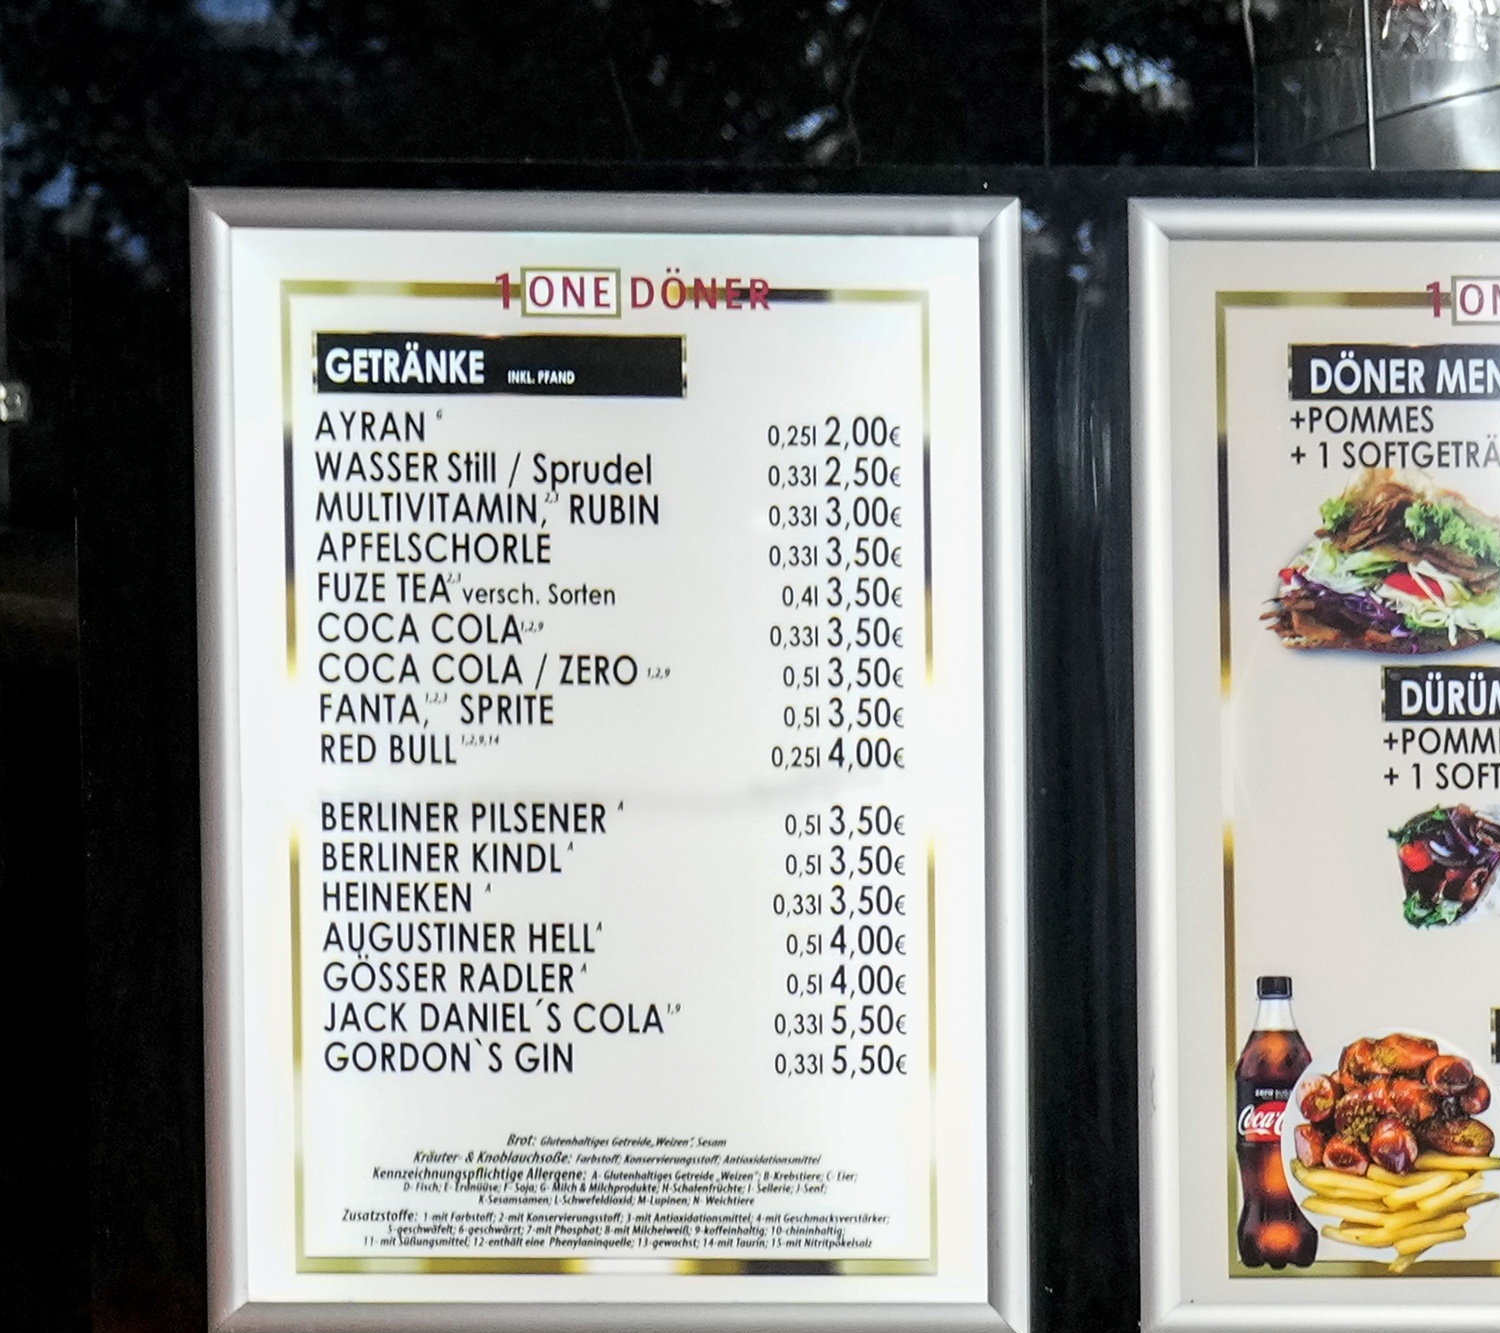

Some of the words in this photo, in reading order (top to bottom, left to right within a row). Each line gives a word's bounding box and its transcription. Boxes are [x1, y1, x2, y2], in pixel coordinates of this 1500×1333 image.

[529, 276, 613, 308] ONE
[630, 268, 771, 311] DÖNER
[326, 345, 484, 383] GETRÄNKE
[1311, 351, 1425, 394] DÖNER
[316, 411, 424, 441] AYRAN
[825, 416, 900, 450] 2,00€
[1290, 406, 1433, 433] +POMMES
[316, 452, 438, 482] WASSER
[448, 452, 495, 482] Still
[534, 453, 651, 491] Sprudel
[825, 456, 900, 490] 2,50€
[570, 494, 658, 524] RUBIN
[826, 496, 901, 530] 3,00€
[318, 532, 550, 563] APFELSCHORLE
[826, 536, 901, 570] 3,50€
[319, 573, 385, 602] FUZE
[397, 573, 452, 603] TEA
[463, 583, 539, 604] versch.
[549, 583, 615, 605] Sorten
[827, 577, 902, 611] 3,50€
[318, 612, 419, 643] COCA
[432, 613, 524, 644] COLA
[828, 617, 902, 651] 3,50€
[319, 653, 420, 683] COCA
[433, 653, 522, 684] COLA
[560, 655, 637, 685] ZERO
[828, 657, 903, 691] 3,50€
[461, 694, 553, 724] SPRITE
[829, 697, 903, 731] 3,50€
[322, 734, 376, 763] RED
[390, 735, 456, 764] BULL
[829, 737, 904, 771] 4,00€
[322, 802, 458, 832] BERLINER
[472, 803, 605, 833] PILSENER
[323, 843, 458, 872] BERLINER
[473, 843, 561, 873] KINDL
[323, 882, 471, 912] HEINEKEN
[324, 922, 515, 957] AUGUSTINER
[529, 923, 595, 952] HELL
[324, 955, 446, 992] GÖSSER
[461, 963, 573, 992] RADLER
[324, 1002, 407, 1032] JACK
[574, 1003, 663, 1033] COLA
[515, 1043, 572, 1073] GIN
[342, 1210, 418, 1222] Zusatzstoffe:
